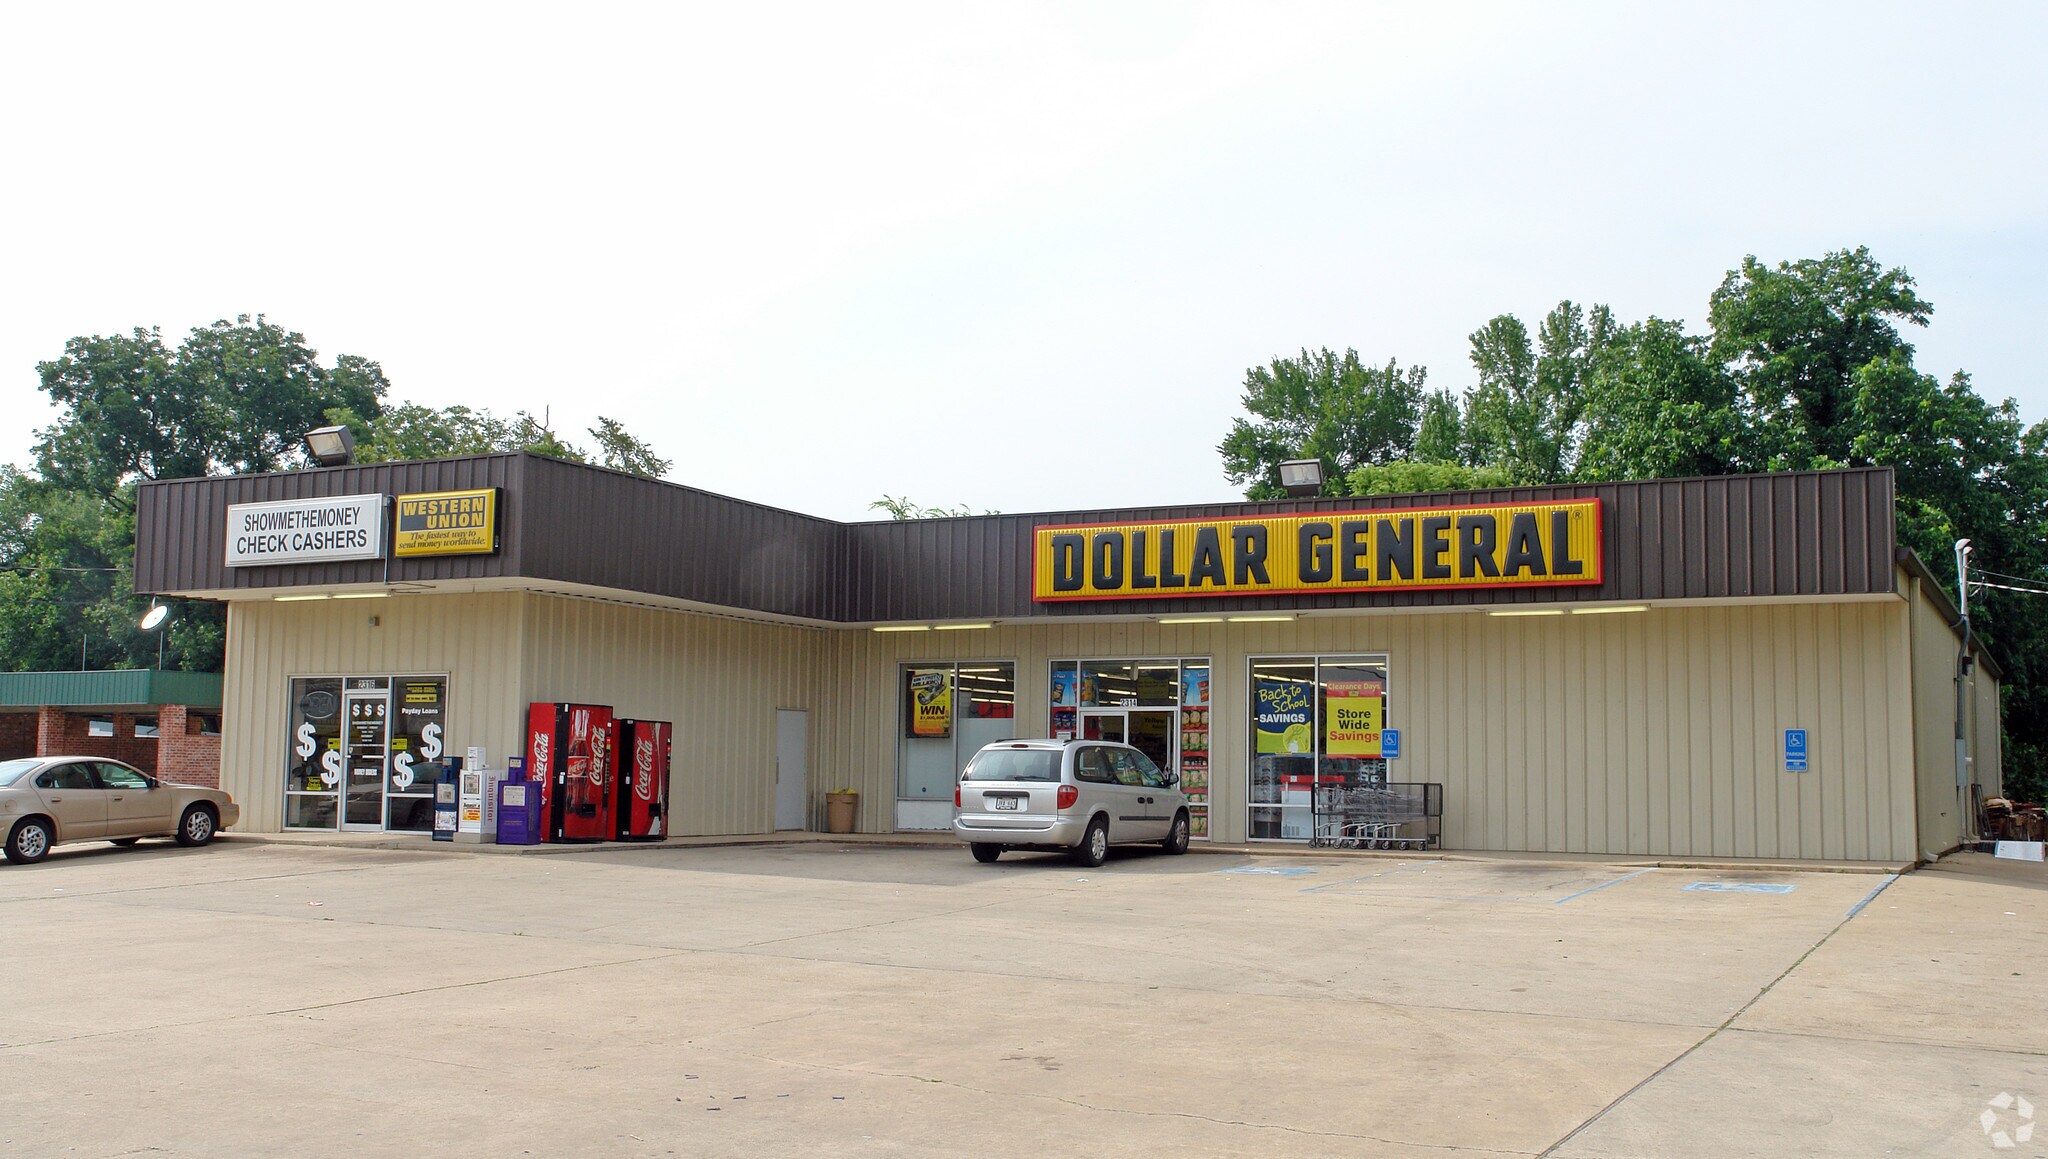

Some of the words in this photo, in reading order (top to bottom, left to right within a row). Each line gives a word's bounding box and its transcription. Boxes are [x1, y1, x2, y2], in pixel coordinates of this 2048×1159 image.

[403, 498, 484, 516] WESTERN
[244, 507, 361, 532] SHOWMETHEMONEY
[427, 512, 484, 529] UNION
[237, 534, 289, 554] CHECK
[292, 529, 367, 551] CASHERS
[411, 532, 424, 540] The
[426, 531, 450, 541] fastest
[452, 532, 468, 540] way
[398, 541, 416, 549] send
[417, 540, 442, 549] money
[1052, 524, 1271, 591] DOLLAR
[1298, 510, 1583, 585] GENERAL
[358, 680, 375, 689] 2316
[1363, 683, 1381, 692] Days
[1258, 684, 1288, 702] Back
[1289, 685, 1302, 697] to
[1120, 699, 1137, 707] 2314
[401, 707, 421, 716] Payday
[920, 705, 946, 715] WIN
[1337, 708, 1371, 719] Store
[1259, 713, 1306, 723] SAVINGS
[1338, 719, 1370, 730] Wide
[1330, 731, 1379, 743] Savings
